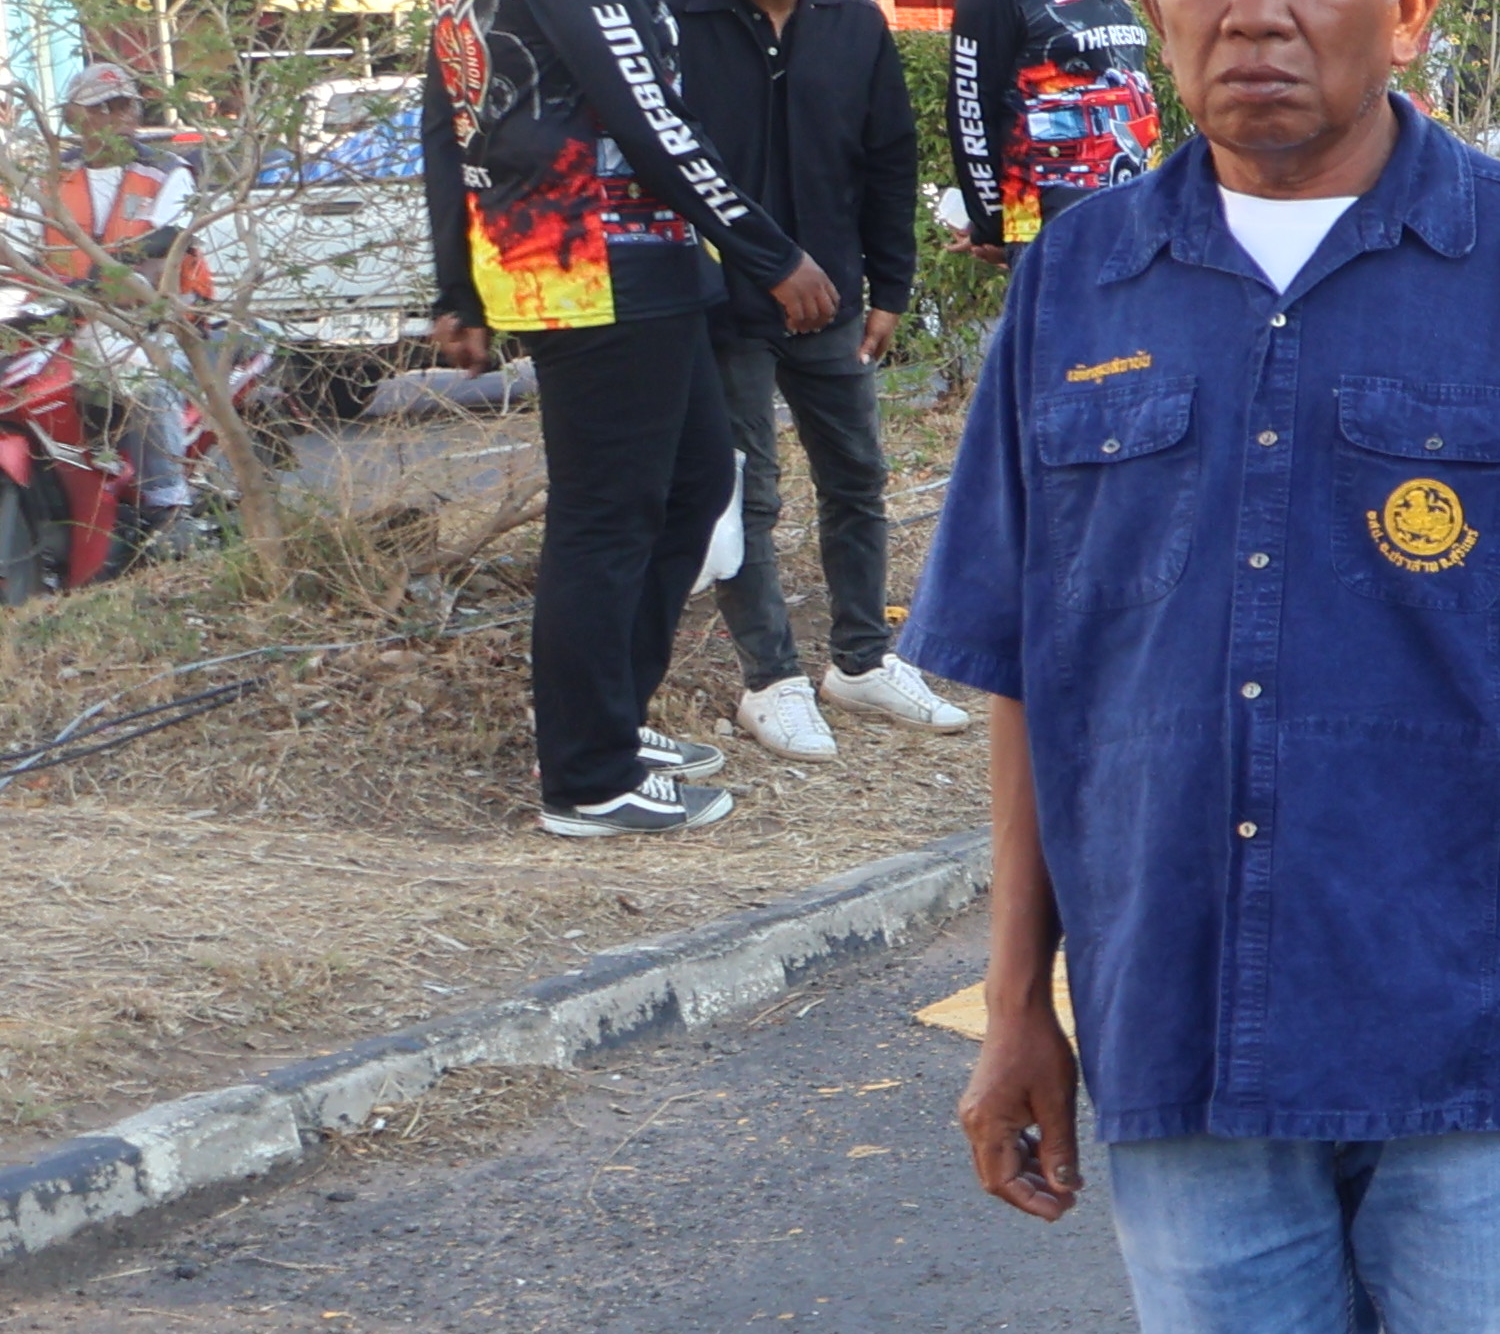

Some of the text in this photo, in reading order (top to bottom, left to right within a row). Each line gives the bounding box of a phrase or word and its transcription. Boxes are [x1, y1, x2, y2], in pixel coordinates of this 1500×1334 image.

[591, 2, 749, 227] THE RESCUE
[956, 35, 1003, 216] THE RESCUE
[1073, 25, 1147, 53] THE RESCU
